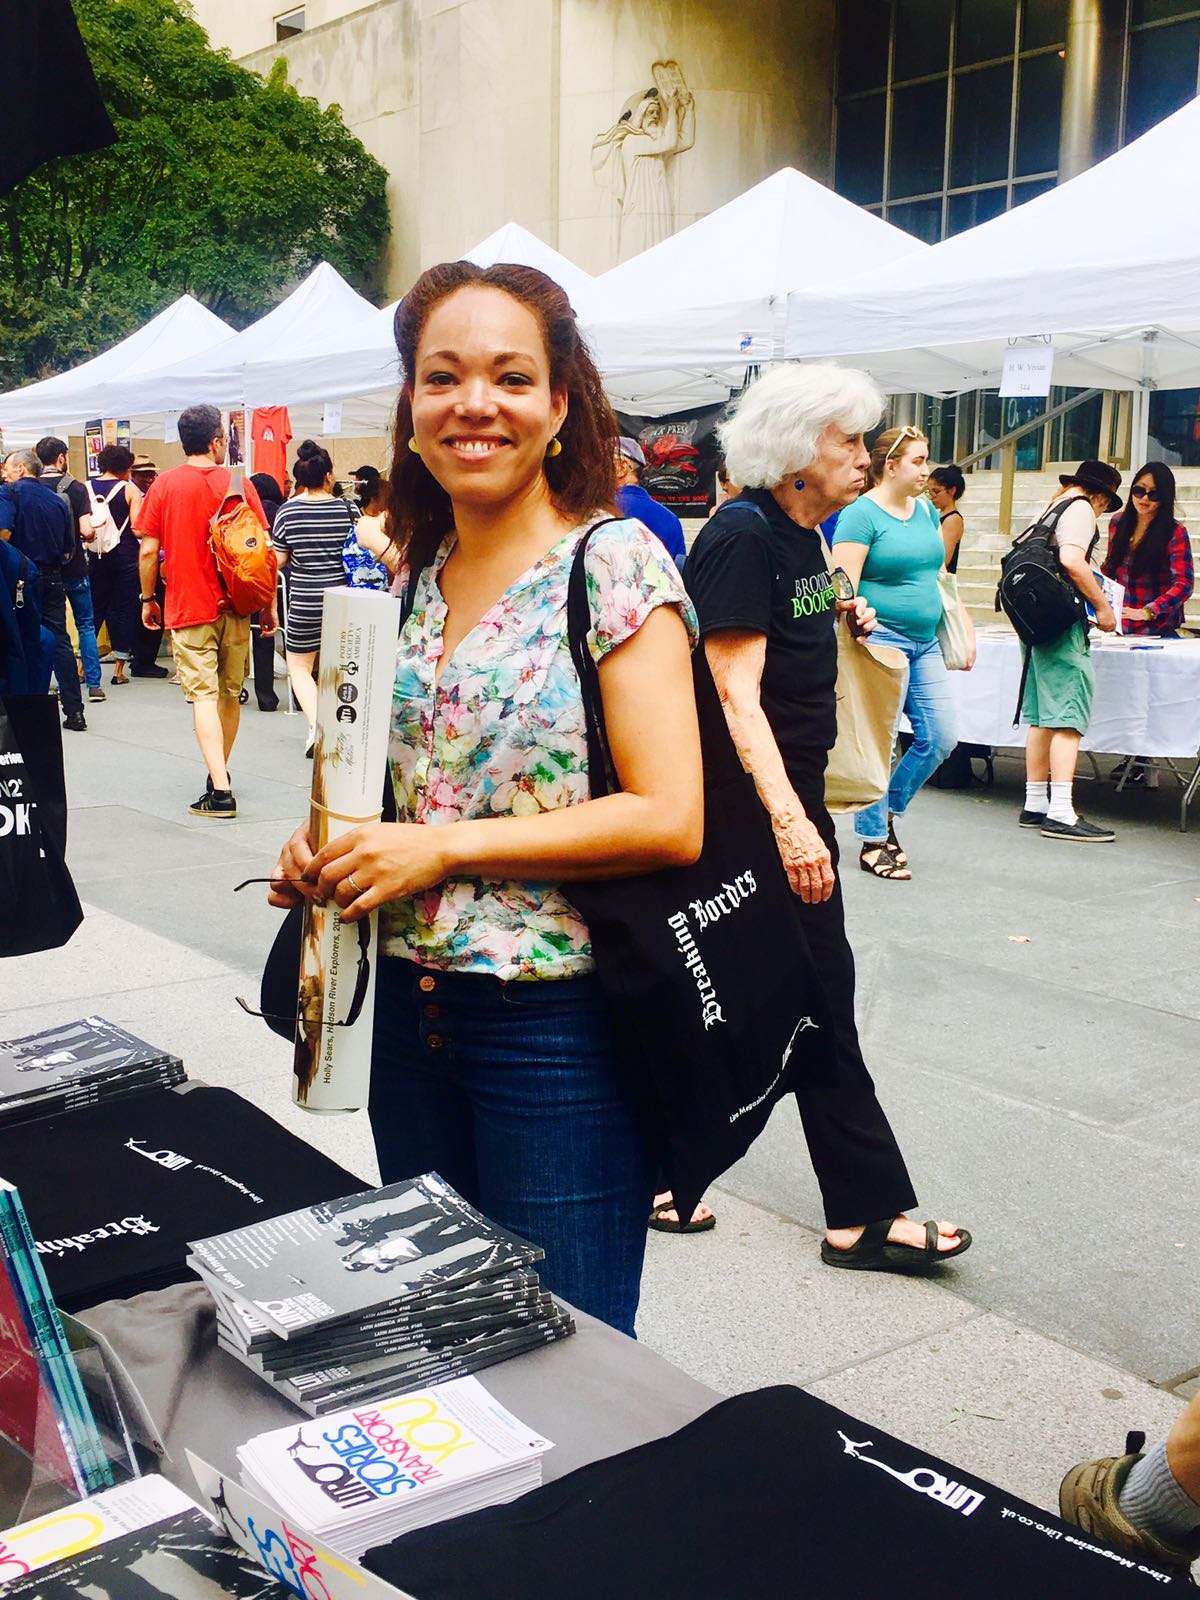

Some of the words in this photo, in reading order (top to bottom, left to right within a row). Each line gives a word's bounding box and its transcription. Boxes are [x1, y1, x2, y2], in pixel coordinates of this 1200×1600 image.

[667, 424, 689, 435] PRESS
[688, 869, 757, 933] Borders
[330, 935, 342, 976] Explorers,
[667, 911, 727, 1031] Breaking
[329, 976, 338, 999] River
[325, 1035, 335, 1062] Sears,
[323, 1056, 334, 1084] Holly
[35, 1214, 160, 1257] Breakin
[194, 1242, 227, 1273] America
[222, 1272, 246, 1290] Latin
[352, 1410, 443, 1485] TRANSPORT
[381, 1396, 476, 1466] YOU
[322, 1424, 417, 1496] STORIES
[306, 1461, 379, 1509] LITRO
[904, 1467, 986, 1516] LITRO
[1000, 1507, 1063, 1541] Litro.co.uk
[1064, 1535, 1137, 1568] Magazine
[1137, 1564, 1173, 1584] Litro
